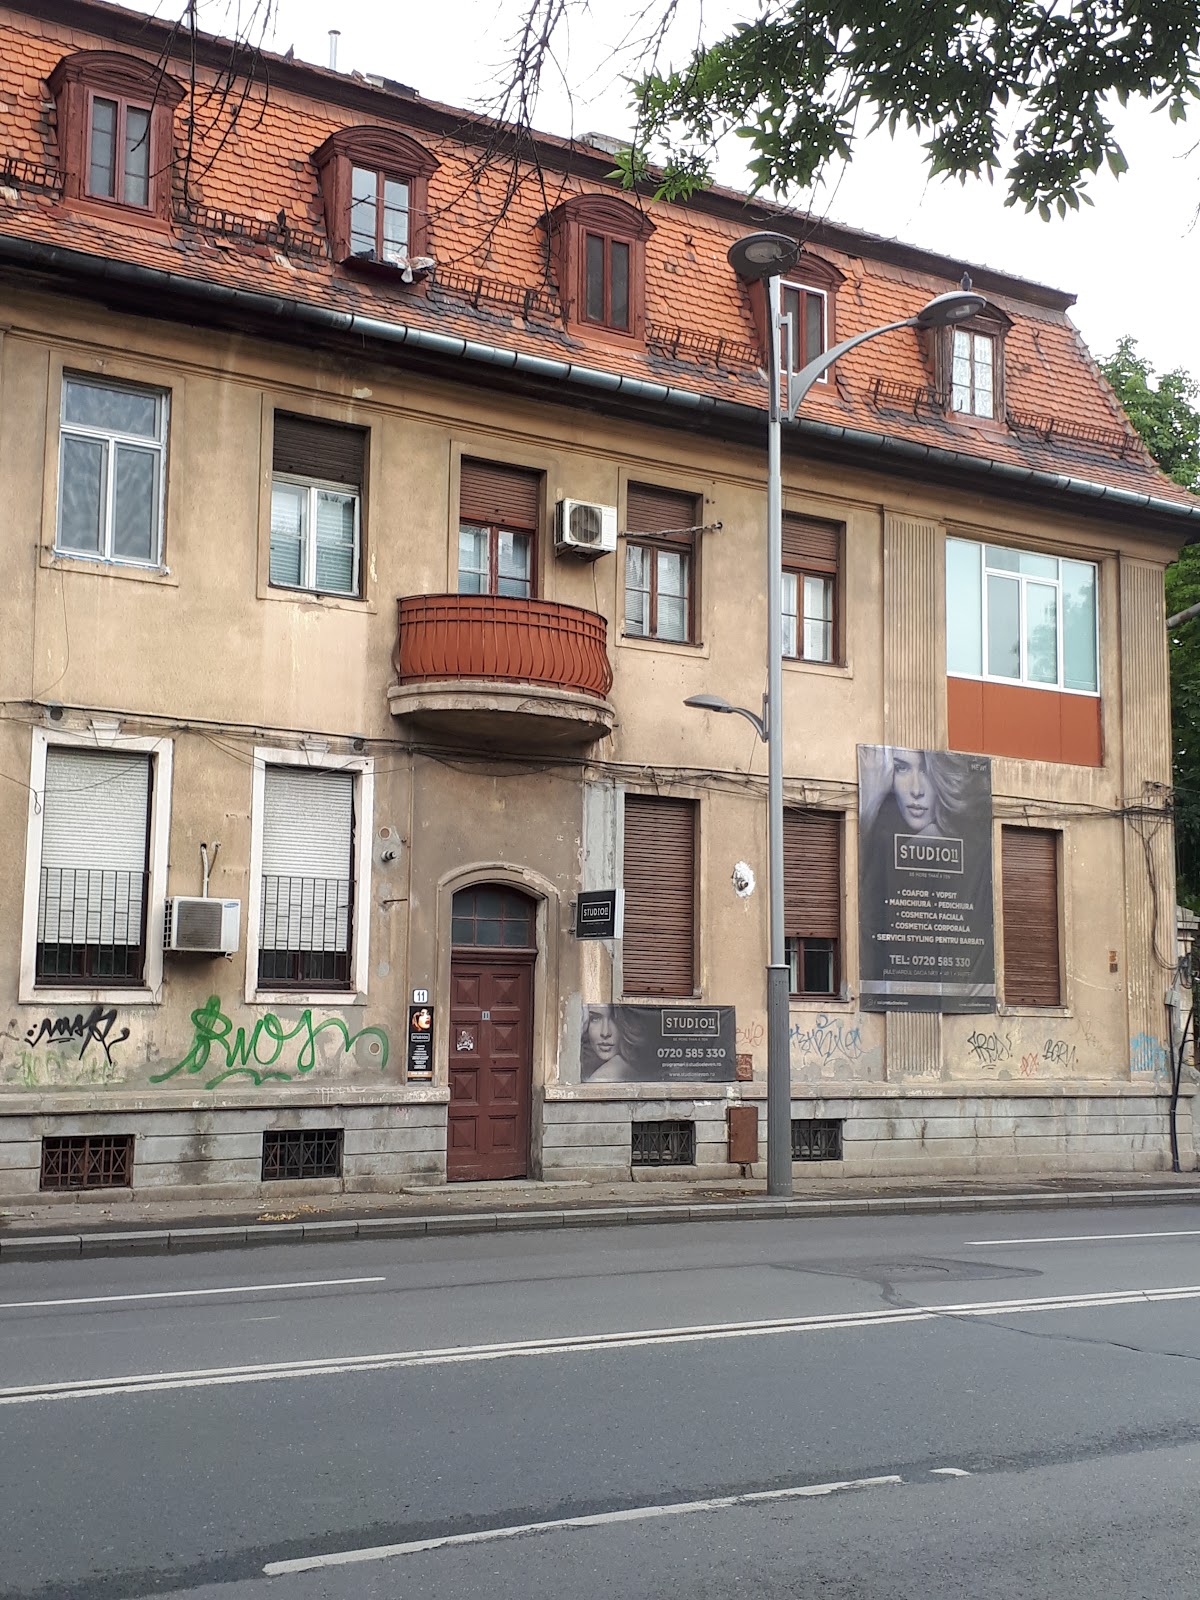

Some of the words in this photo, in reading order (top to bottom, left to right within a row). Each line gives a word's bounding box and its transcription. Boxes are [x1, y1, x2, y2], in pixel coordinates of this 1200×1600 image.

[902, 889, 929, 897] COAFOR
[936, 891, 957, 899] VOPSIT
[890, 899, 931, 907] MANICHIURA
[938, 902, 973, 910] PEDICHIURA
[901, 911, 937, 919] COSMETICA
[939, 913, 964, 921] FACIALA
[895, 922, 932, 931] COSMETICA
[934, 924, 970, 932] CORPORALA
[889, 955, 910, 965] TEL:
[912, 956, 935, 965] 0720
[938, 957, 953, 966] 585
[955, 958, 970, 967] 330
[417, 991, 425, 1001] 11
[657, 1048, 682, 1058] 0720
[685, 1048, 703, 1058] 585
[706, 1048, 726, 1058] 330
